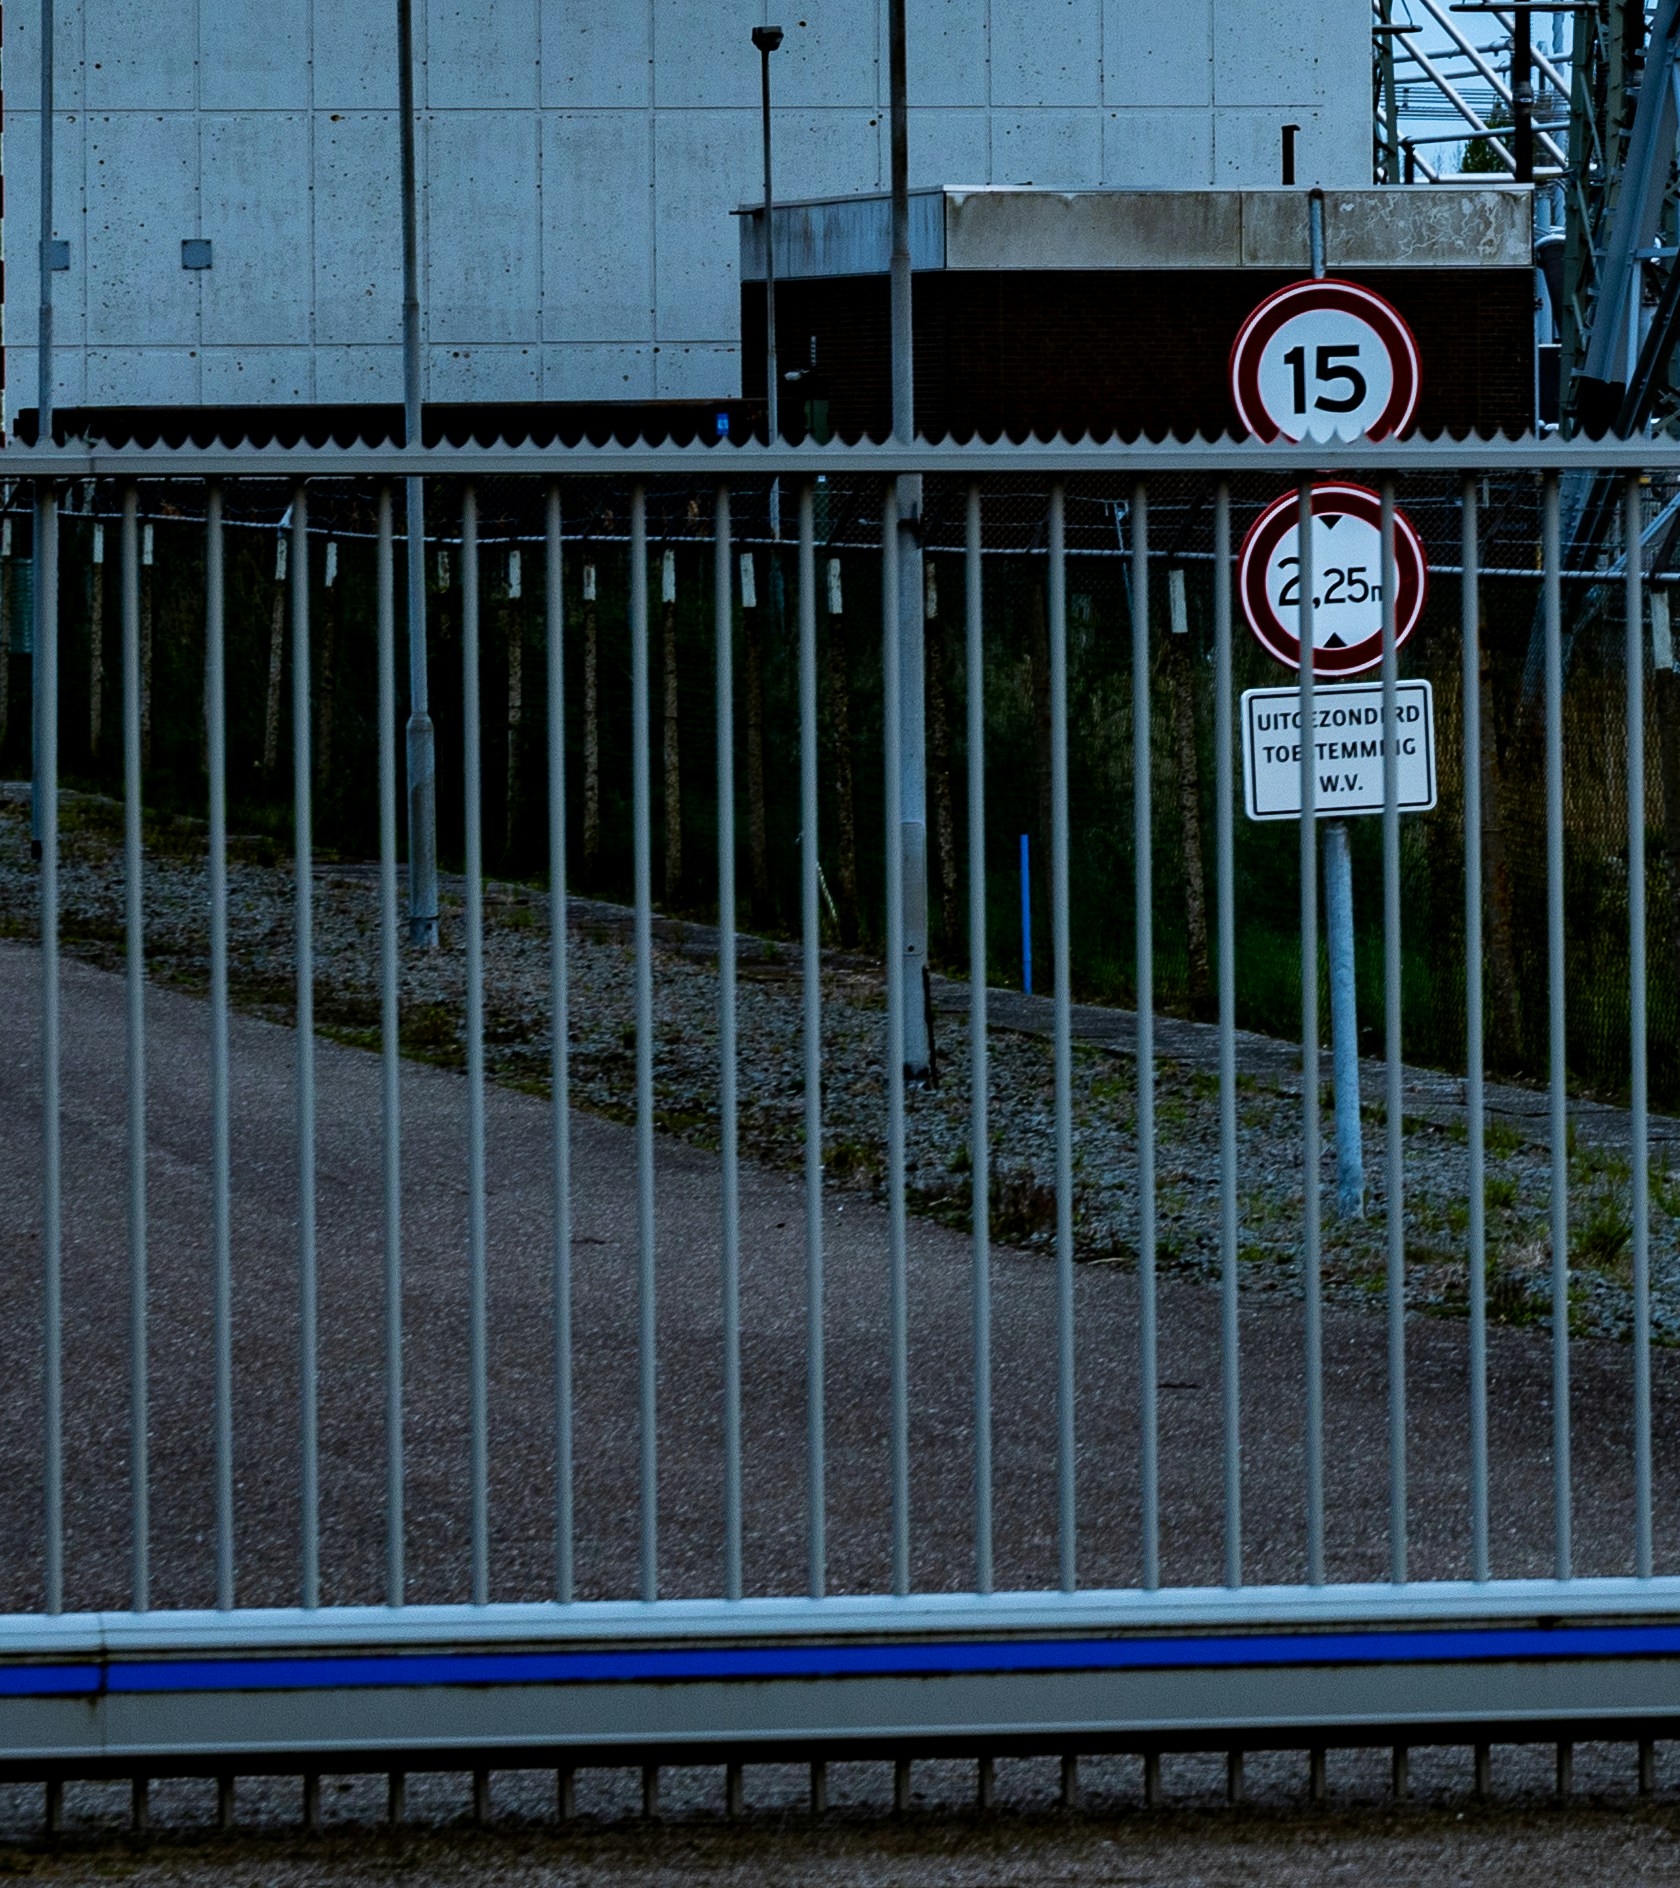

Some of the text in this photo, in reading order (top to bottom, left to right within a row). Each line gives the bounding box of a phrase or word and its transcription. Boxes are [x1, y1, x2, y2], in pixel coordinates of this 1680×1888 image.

[1283, 345, 1367, 414] 15
[1258, 705, 1420, 731] UITGZONDRD
[1263, 738, 1416, 763] TOETEMMIG
[1320, 774, 1363, 792] W.V.
